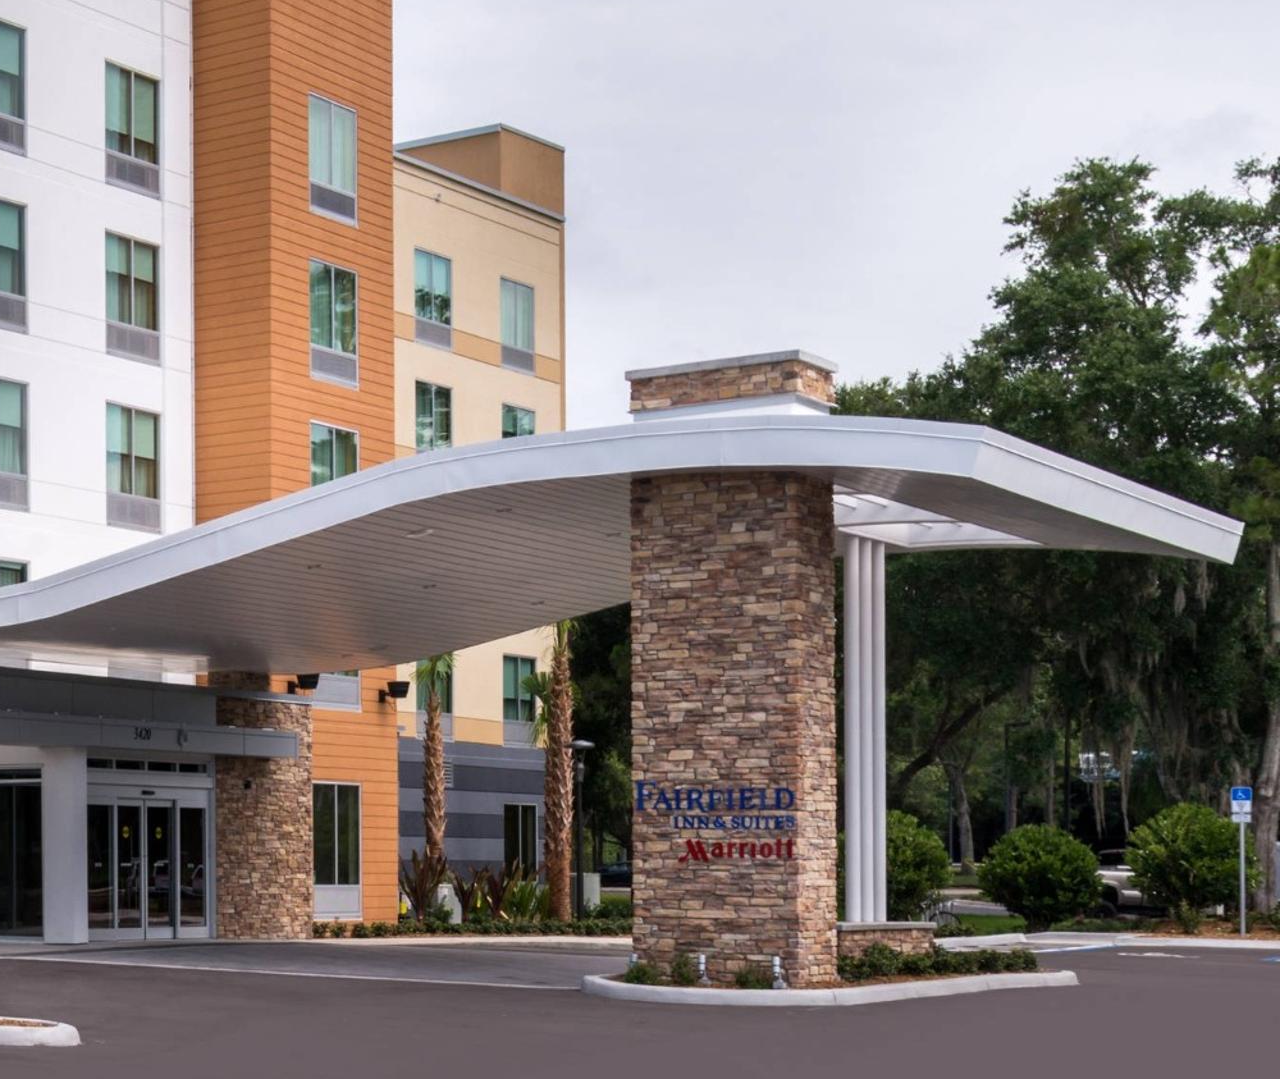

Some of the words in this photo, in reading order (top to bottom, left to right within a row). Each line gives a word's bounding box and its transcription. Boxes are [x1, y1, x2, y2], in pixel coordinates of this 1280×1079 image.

[635, 780, 795, 813] FAIRFIELD
[673, 815, 709, 830] INN
[713, 816, 727, 830] &
[731, 815, 796, 830] SUITES
[678, 838, 796, 863] Marriott
